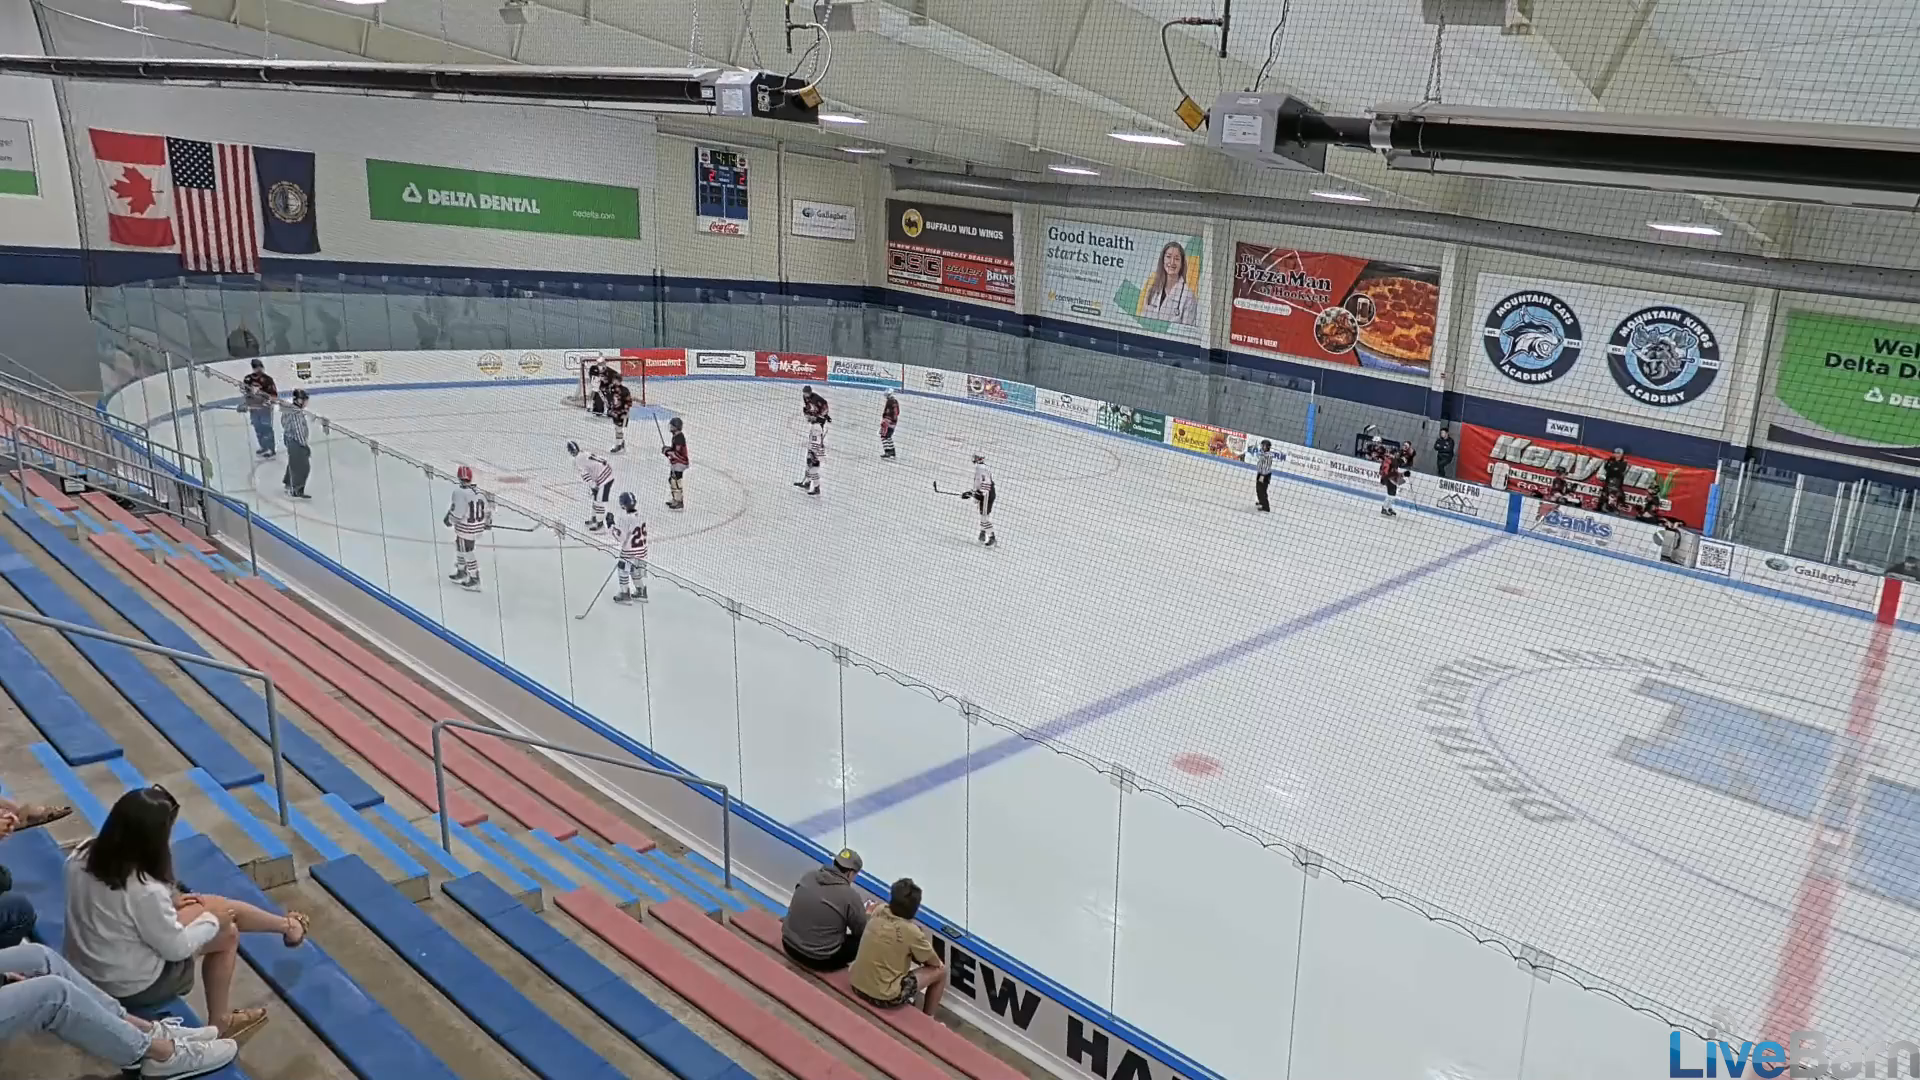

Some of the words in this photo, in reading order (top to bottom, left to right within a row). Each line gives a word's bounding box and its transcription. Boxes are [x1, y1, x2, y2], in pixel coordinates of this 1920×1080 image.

[708, 169, 717, 182] 2
[739, 172, 747, 185] 2
[427, 188, 477, 209] DELTA
[479, 193, 541, 214] DENTAL
[925, 221, 957, 233] BUFFALO
[958, 225, 977, 236] WILD
[978, 227, 1004, 240] WINGS
[1047, 226, 1085, 245] Good
[1087, 231, 1135, 251] health
[889, 249, 942, 276] CSG
[1046, 246, 1090, 264] starts
[1092, 250, 1125, 268] here
[1240, 252, 1262, 266] The
[1274, 286, 1331, 303] Hooksett
[1496, 294, 1552, 318] MOUNTAIN
[1552, 302, 1574, 326] CATS
[1618, 310, 1682, 338] MOUNTAIN
[1684, 316, 1714, 350] KINGS
[1501, 362, 1555, 382] ACADEMY
[1824, 352, 1890, 375] Delta
[1044, 397, 1089, 413] MELANSON
[1626, 383, 1686, 405] ACADEMY
[1549, 422, 1576, 434] AWAY
[1329, 460, 1381, 480] MILESTON
[1438, 478, 1466, 494] SHINGLE
[1466, 485, 1480, 498] PRO
[466, 498, 485, 524] 10
[1545, 509, 1614, 539] Banks
[1793, 565, 1859, 588] Gallagher
